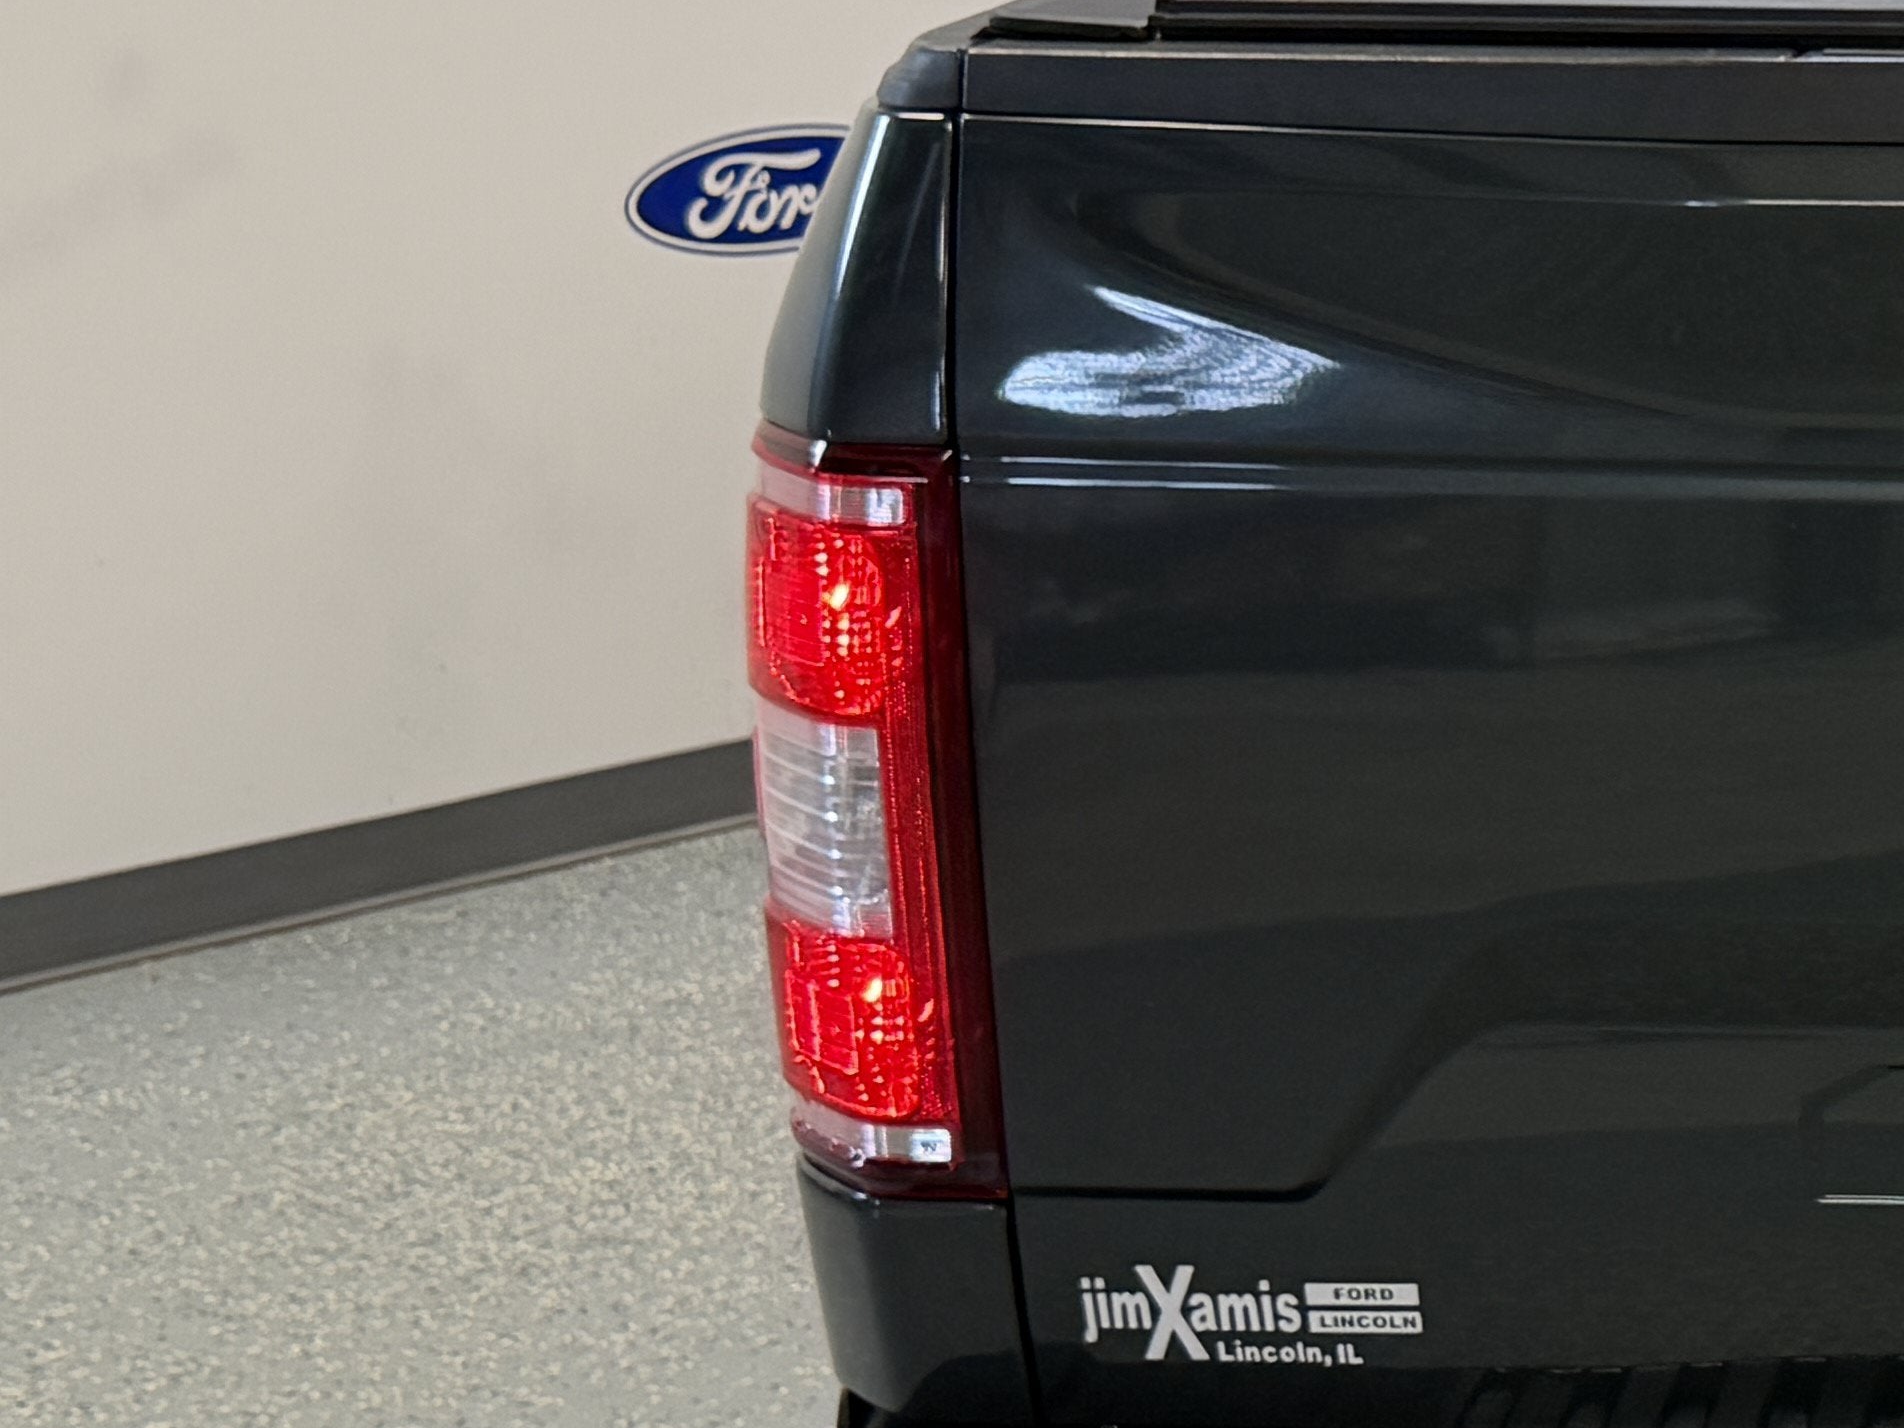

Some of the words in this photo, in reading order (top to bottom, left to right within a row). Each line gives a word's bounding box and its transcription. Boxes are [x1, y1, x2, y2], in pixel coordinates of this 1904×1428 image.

[685, 146, 824, 241] For
[1332, 1286, 1395, 1302] FORD
[1318, 1314, 1418, 1330] LINCOLN
[1215, 1338, 1334, 1368] Lincoln,
[1335, 1342, 1365, 1366] IL
